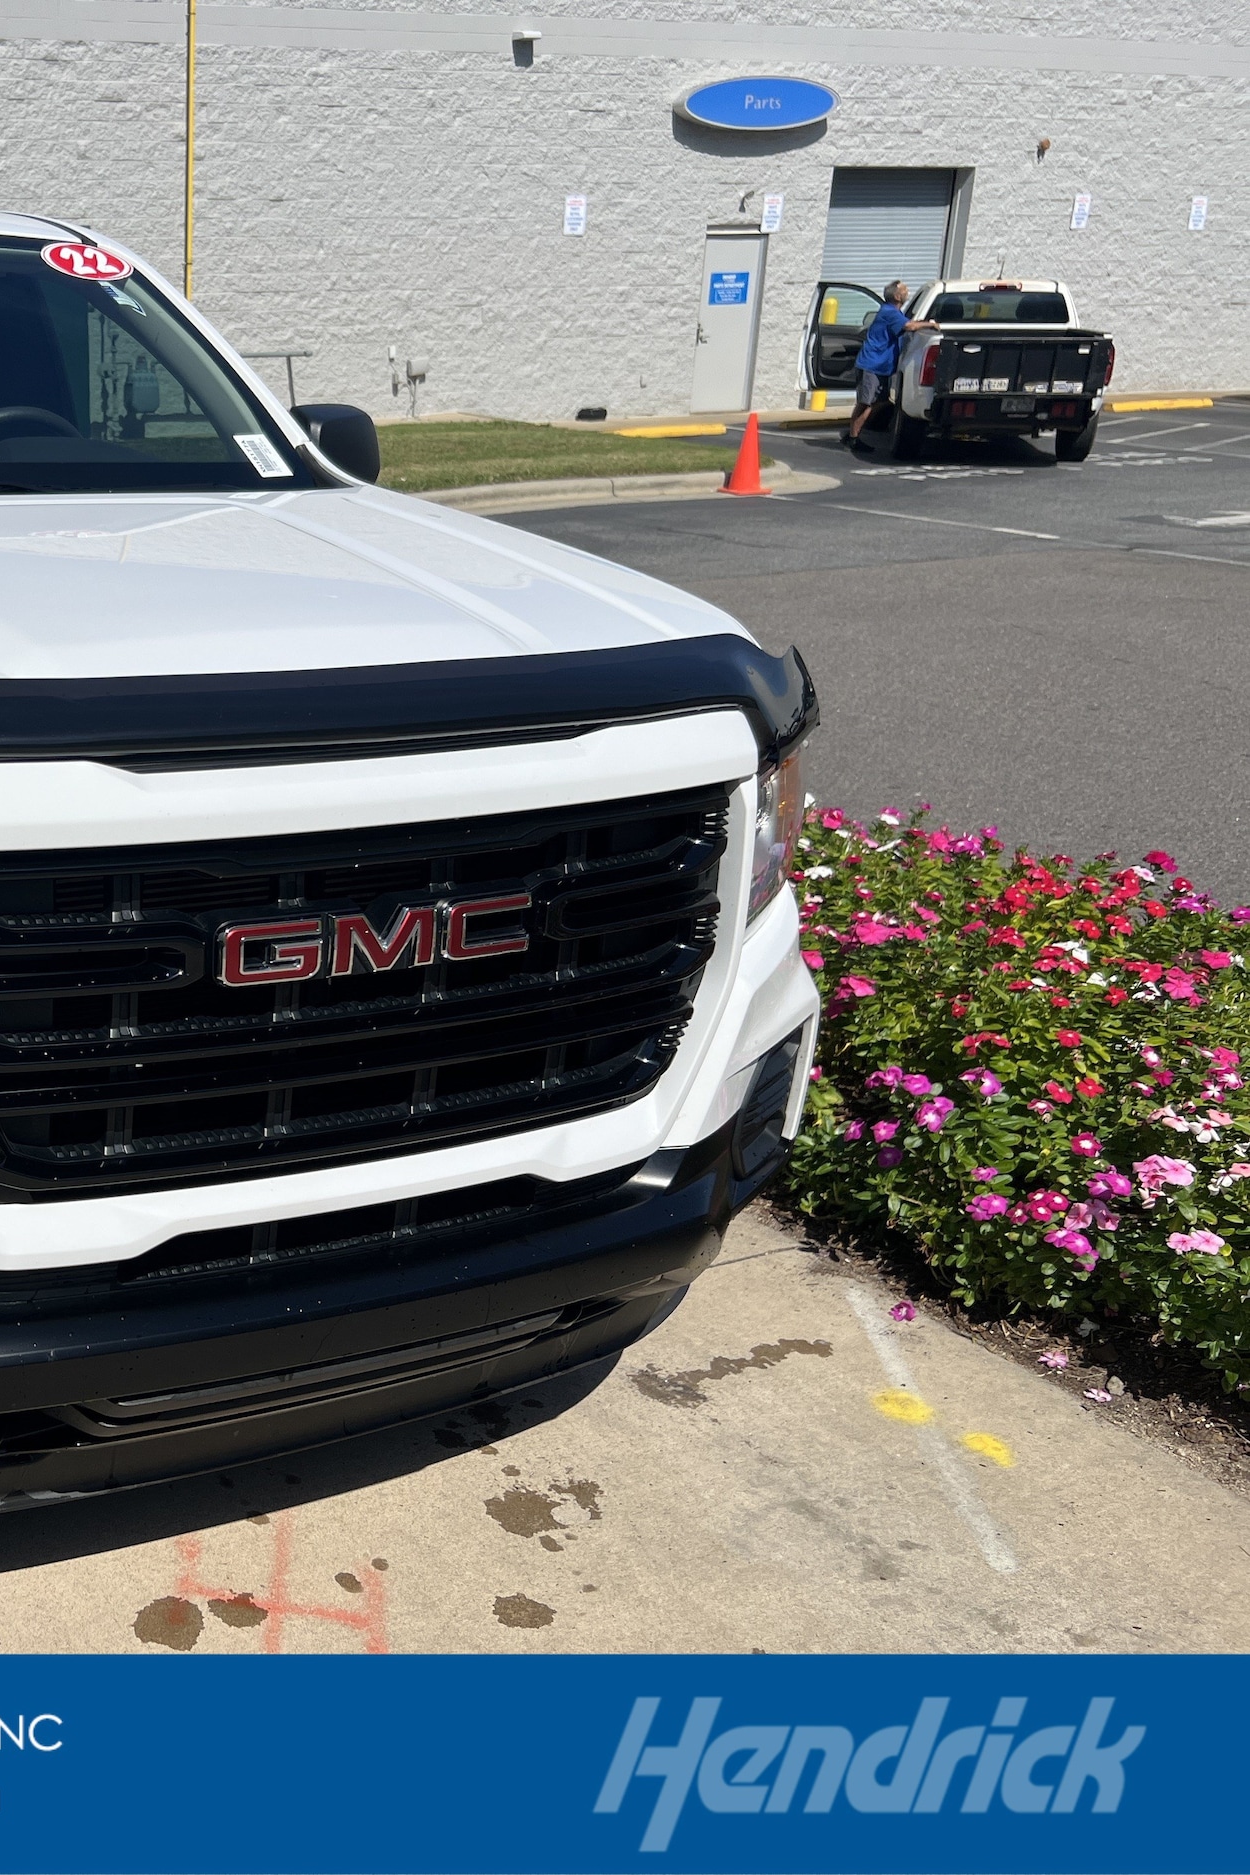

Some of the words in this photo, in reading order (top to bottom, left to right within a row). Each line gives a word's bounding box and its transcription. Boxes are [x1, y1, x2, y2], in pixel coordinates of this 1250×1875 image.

[745, 95, 781, 109] Parts
[59, 247, 121, 275] 22
[221, 892, 532, 987] GMC
